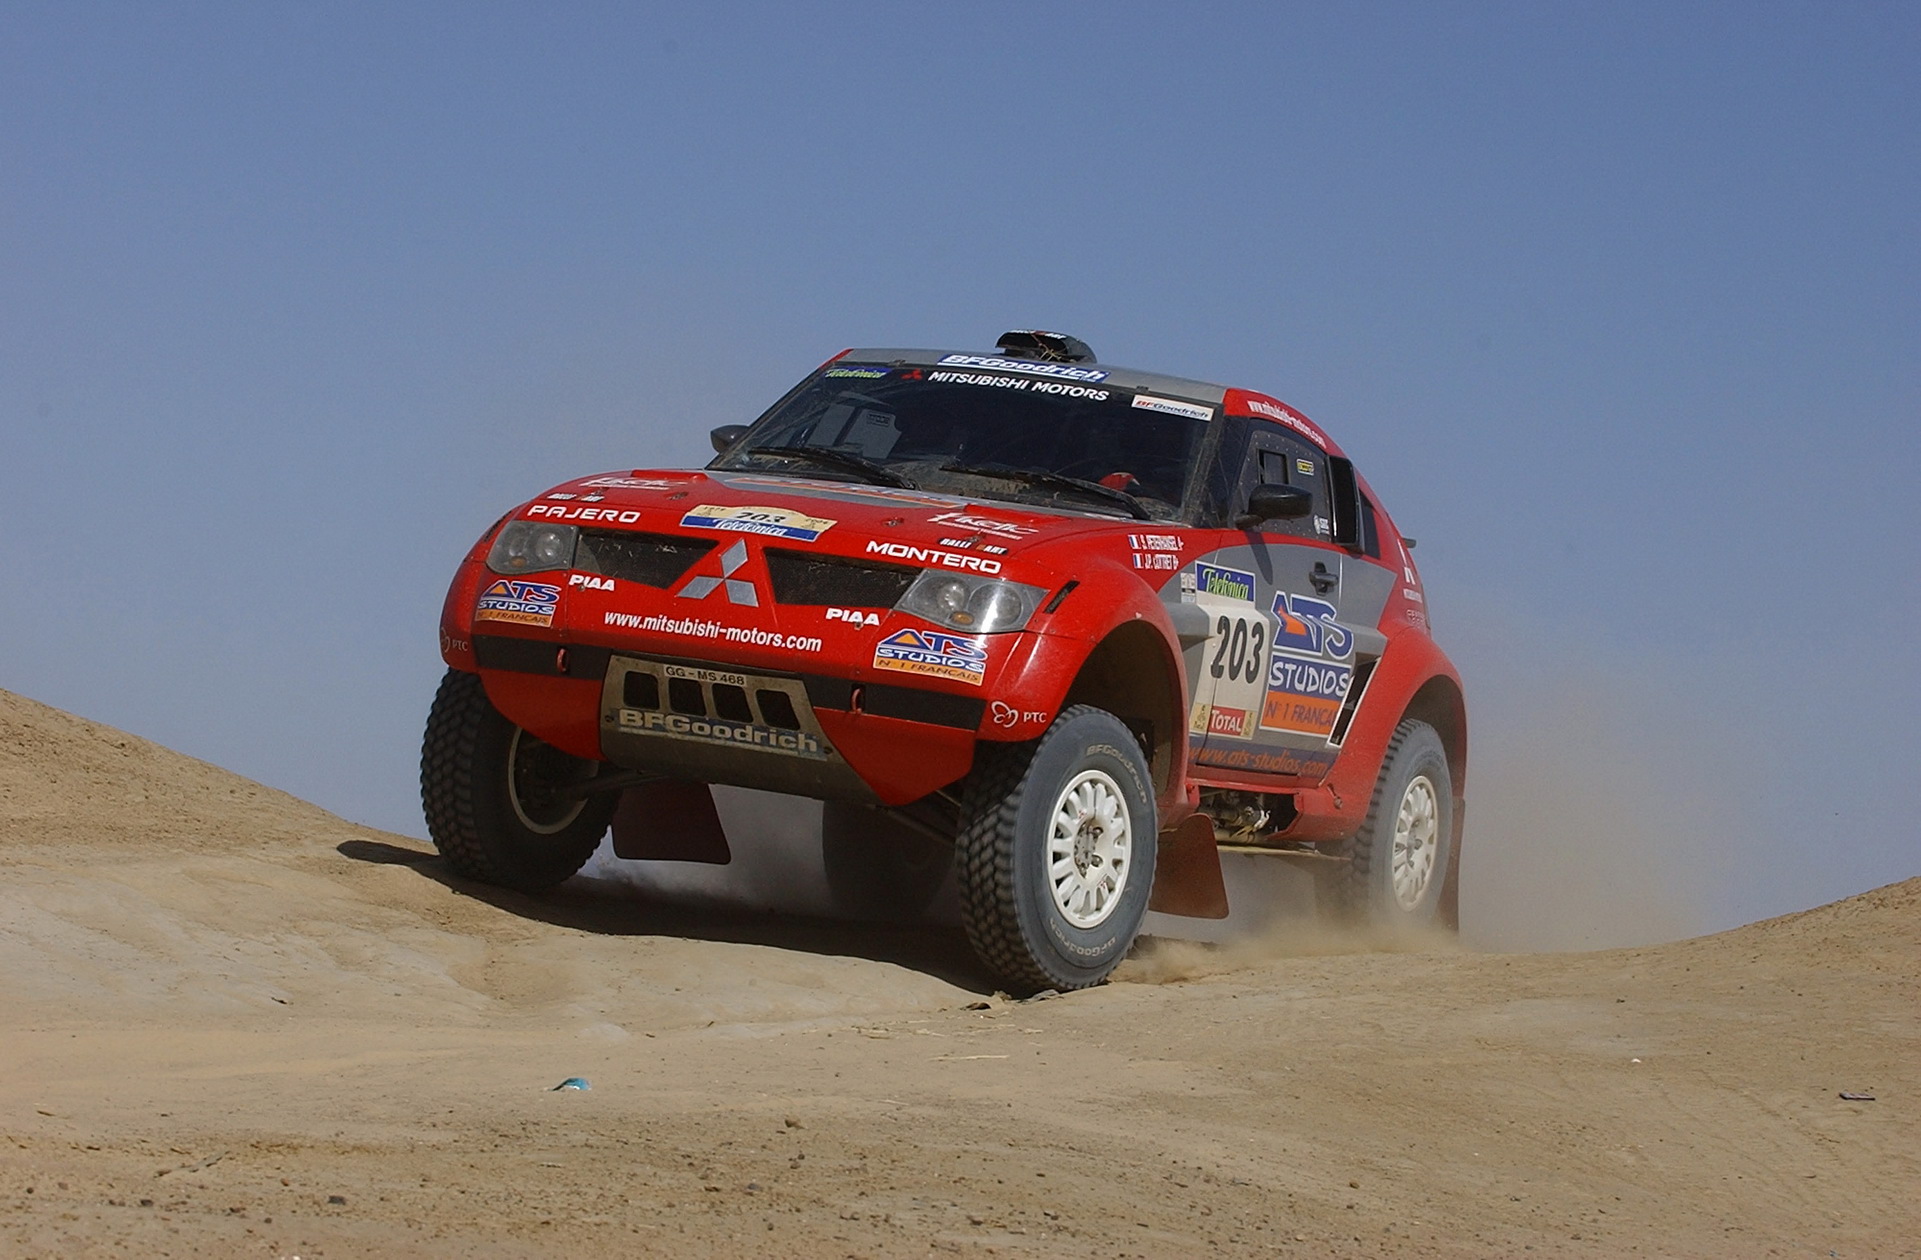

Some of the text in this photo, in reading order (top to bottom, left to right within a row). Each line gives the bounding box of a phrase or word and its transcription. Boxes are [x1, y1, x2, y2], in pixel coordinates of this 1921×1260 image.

[943, 354, 1106, 380] BFGoodrich
[928, 371, 1111, 401] MITSUBISHI MOTORS
[1136, 400, 1209, 418] BFGoodrich
[527, 505, 641, 524] PAJERO
[736, 511, 786, 523] 203
[865, 540, 1002, 574] MONTERO
[480, 579, 562, 604] ATS
[568, 574, 615, 592] PIAA
[477, 600, 554, 614] STUDIOS
[825, 608, 880, 626] PIAA
[604, 611, 822, 652] www.mitsubishi-motors.com
[1271, 591, 1354, 660] ATS
[452, 638, 469, 651] PTC
[877, 628, 988, 661] ATS
[1210, 615, 1265, 684] 203
[877, 648, 983, 673] STUDIOS
[666, 666, 686, 677] GG
[697, 670, 717, 681] MS
[720, 674, 745, 685] 468
[1268, 661, 1352, 697] STUDIOS
[1023, 711, 1047, 723] PTC
[618, 709, 818, 752] BFGoodrich
